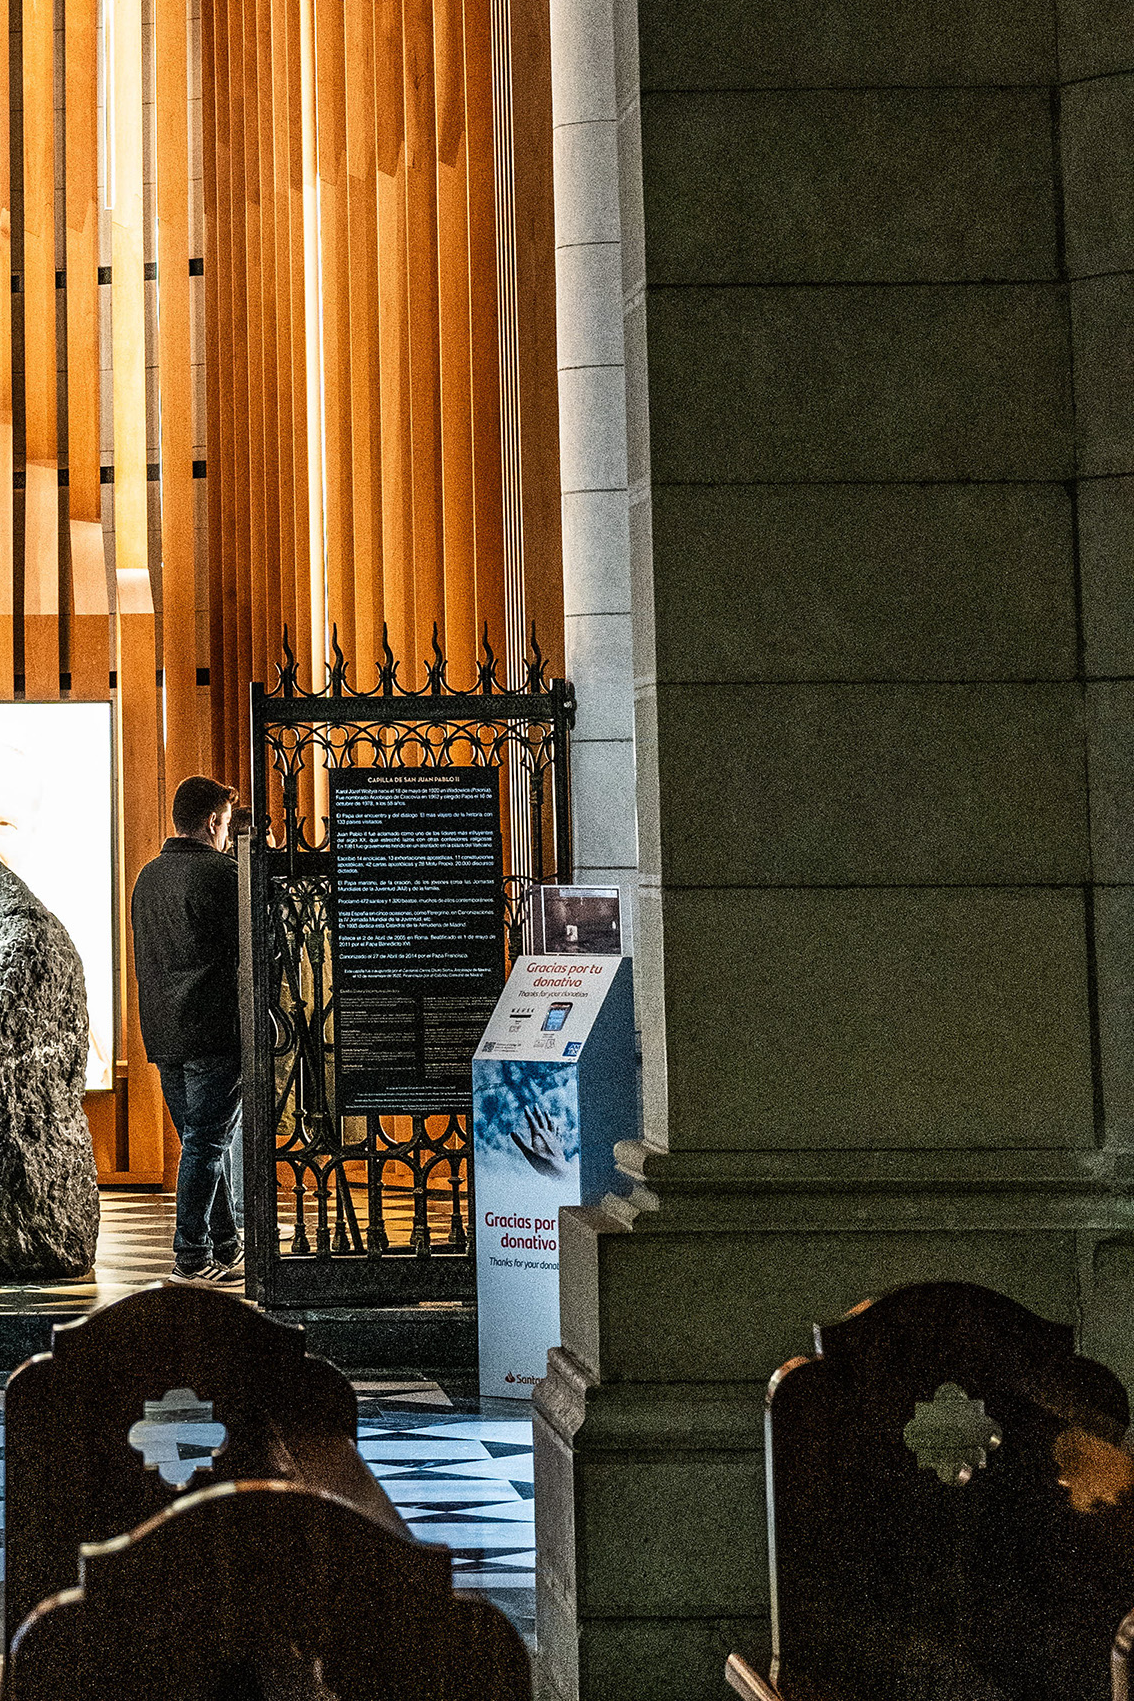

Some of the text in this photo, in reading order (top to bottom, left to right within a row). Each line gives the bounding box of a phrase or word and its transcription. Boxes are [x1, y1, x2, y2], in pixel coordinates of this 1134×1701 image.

[526, 962, 603, 978] Gracias por tu
[533, 977, 583, 988] donativo
[518, 990, 539, 998] Thanks
[484, 1212, 556, 1233] Gracias por
[500, 1233, 557, 1251] donativo
[489, 1256, 513, 1268] Thanks
[513, 1258, 524, 1268] for
[523, 1261, 539, 1270] your
